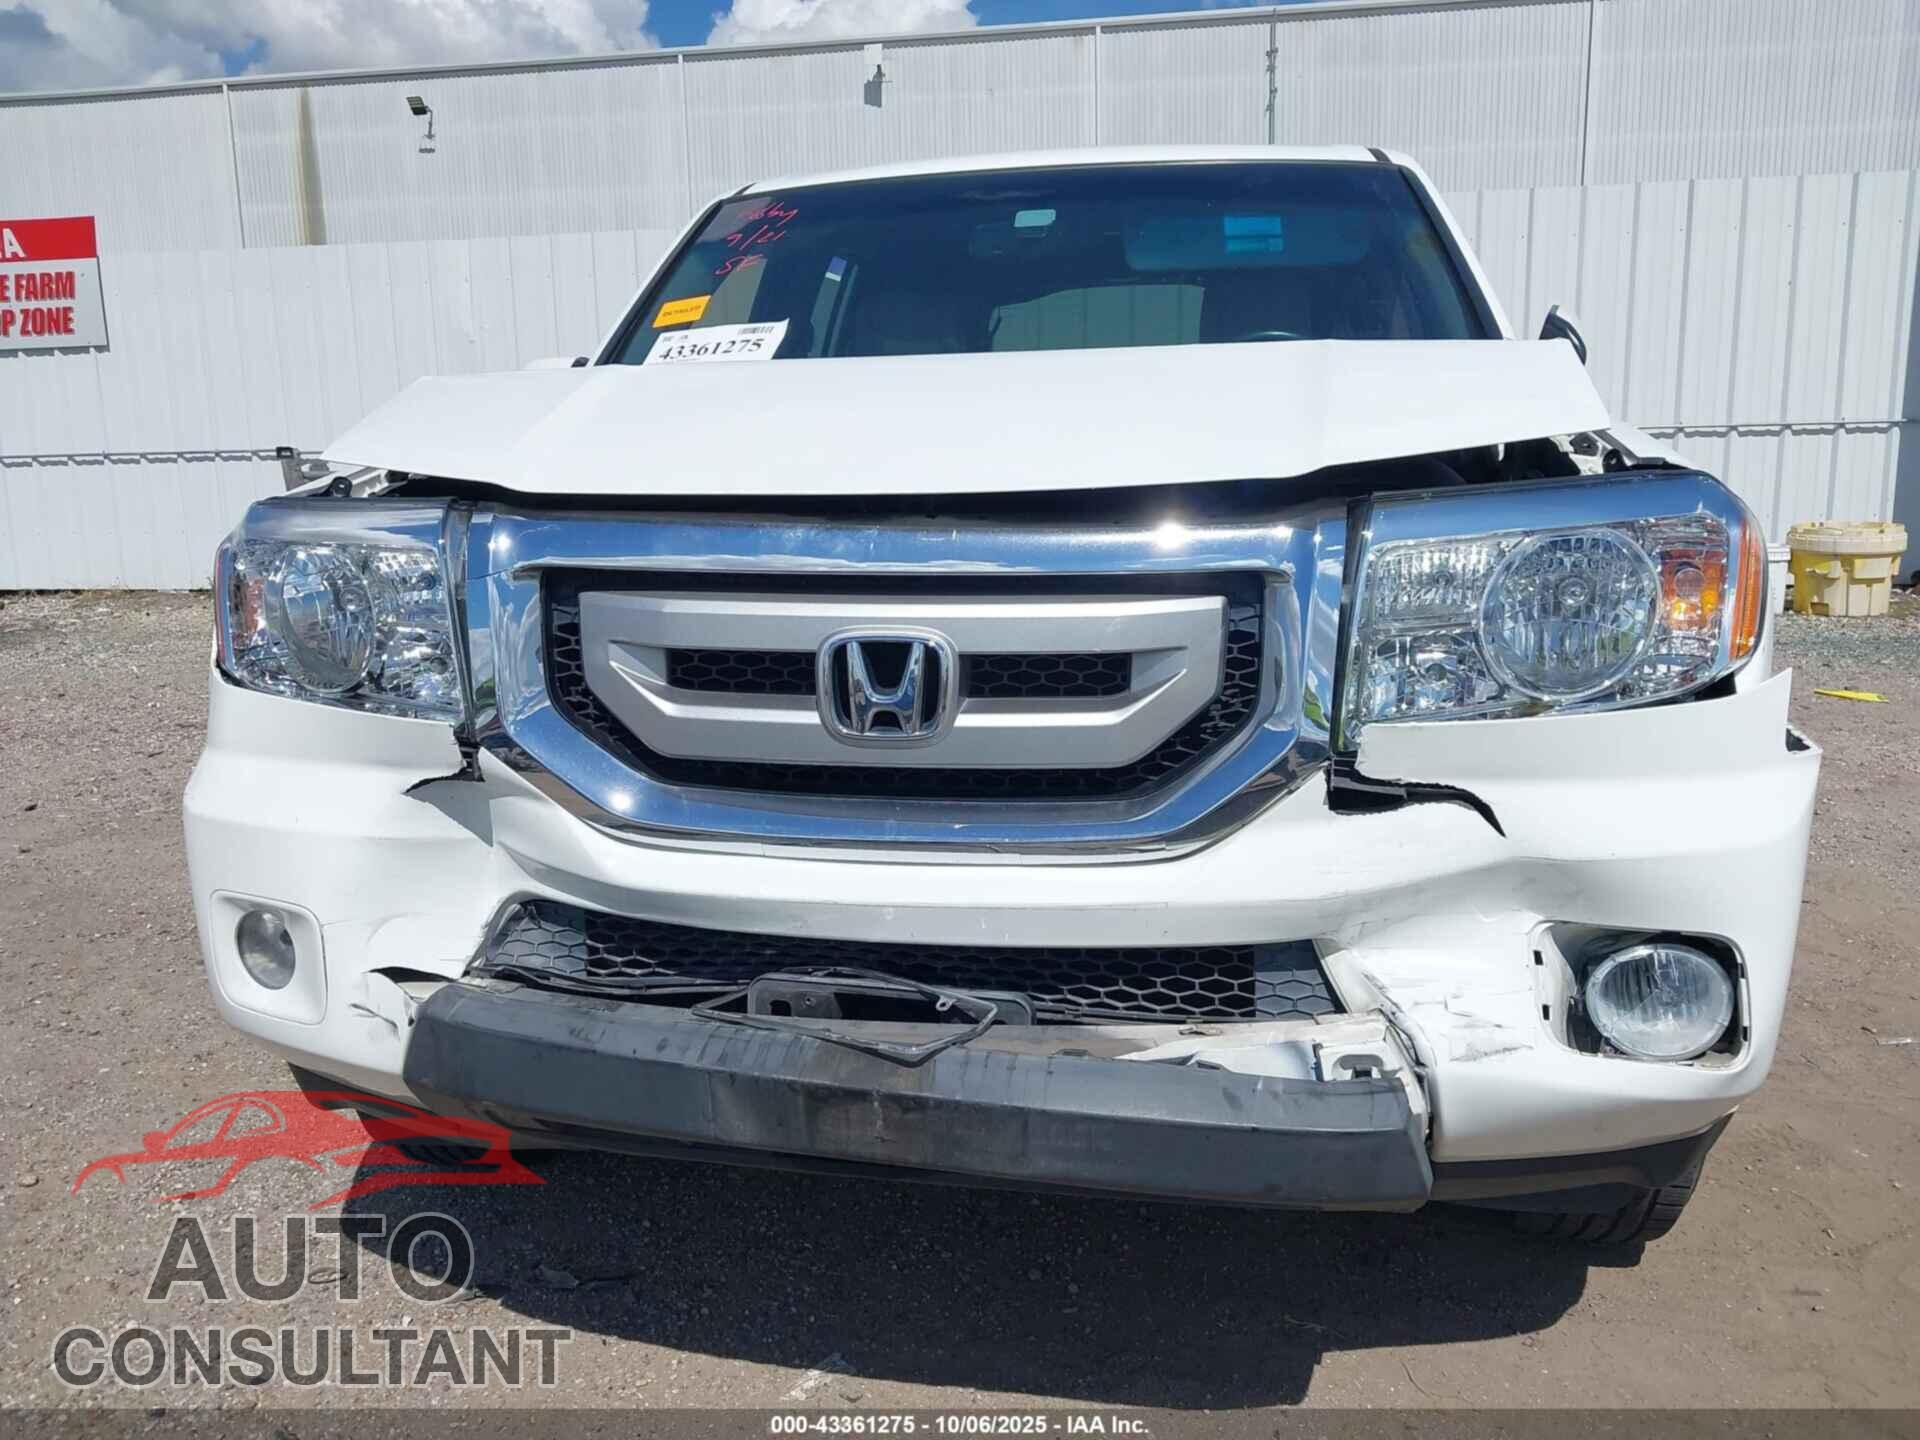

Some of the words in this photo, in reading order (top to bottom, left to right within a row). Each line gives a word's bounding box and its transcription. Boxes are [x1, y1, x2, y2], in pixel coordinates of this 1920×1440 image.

[0, 228, 26, 259] A
[14, 271, 75, 301] FARM
[20, 306, 75, 336] ZONE
[659, 338, 765, 360] 43361275
